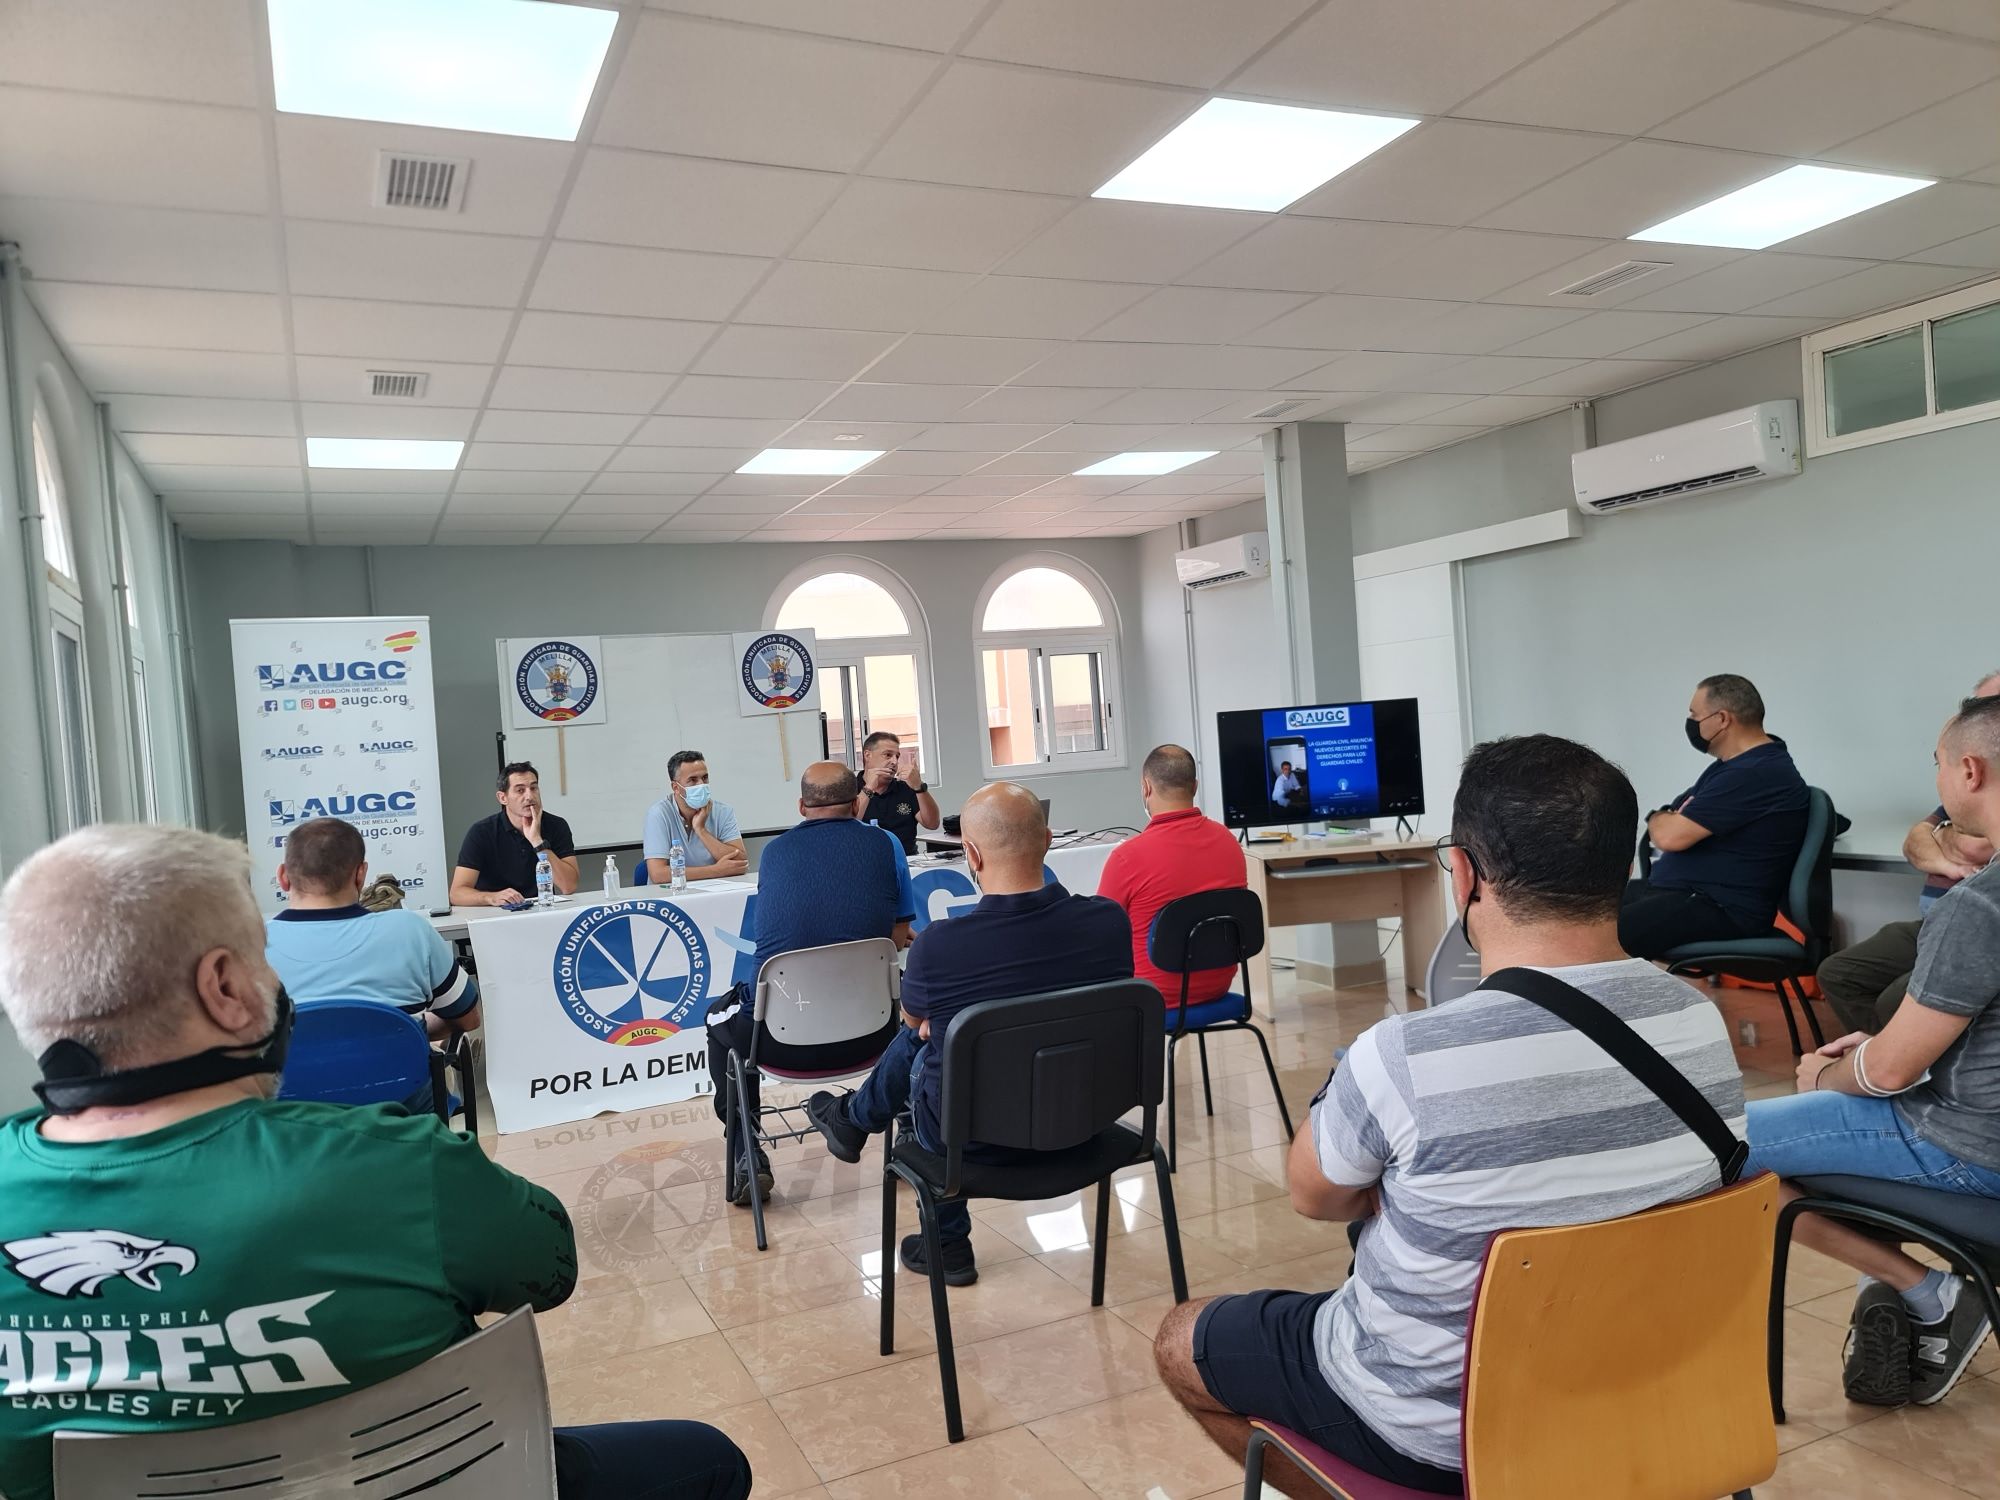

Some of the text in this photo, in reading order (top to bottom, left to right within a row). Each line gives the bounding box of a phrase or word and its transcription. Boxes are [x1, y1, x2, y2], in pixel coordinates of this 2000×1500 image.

[522, 644, 557, 669] UNIFICADA
[538, 653, 573, 664] MELILLA
[747, 636, 777, 661] UNIFICADA
[760, 644, 791, 655] MELILLA
[789, 640, 811, 672] GUARDIAS
[290, 660, 406, 683] AUGC
[571, 649, 595, 683] GUARDIAS
[518, 671, 544, 713] ASOCIACIÓN
[576, 685, 595, 712] CIVILES
[795, 674, 811, 699] CIVILES
[341, 694, 408, 707] augc.org
[1305, 710, 1345, 723] AUGC
[277, 745, 324, 756] AUGC
[370, 740, 414, 750] AUGC
[300, 791, 416, 818] AUGC
[362, 825, 417, 839] ugc.org
[558, 902, 704, 1034] ASOCIACIÓN UNIFICADA DE GUARDIAS CIVILES
[631, 1028, 658, 1039] AUGC
[530, 1050, 706, 1098] POR LA DEM
[0, 1309, 210, 1328] HILADELPHIA
[0, 1290, 351, 1396] AGLES
[1918, 1335, 1948, 1365] N
[11, 1393, 245, 1417] EAGLES FLY
